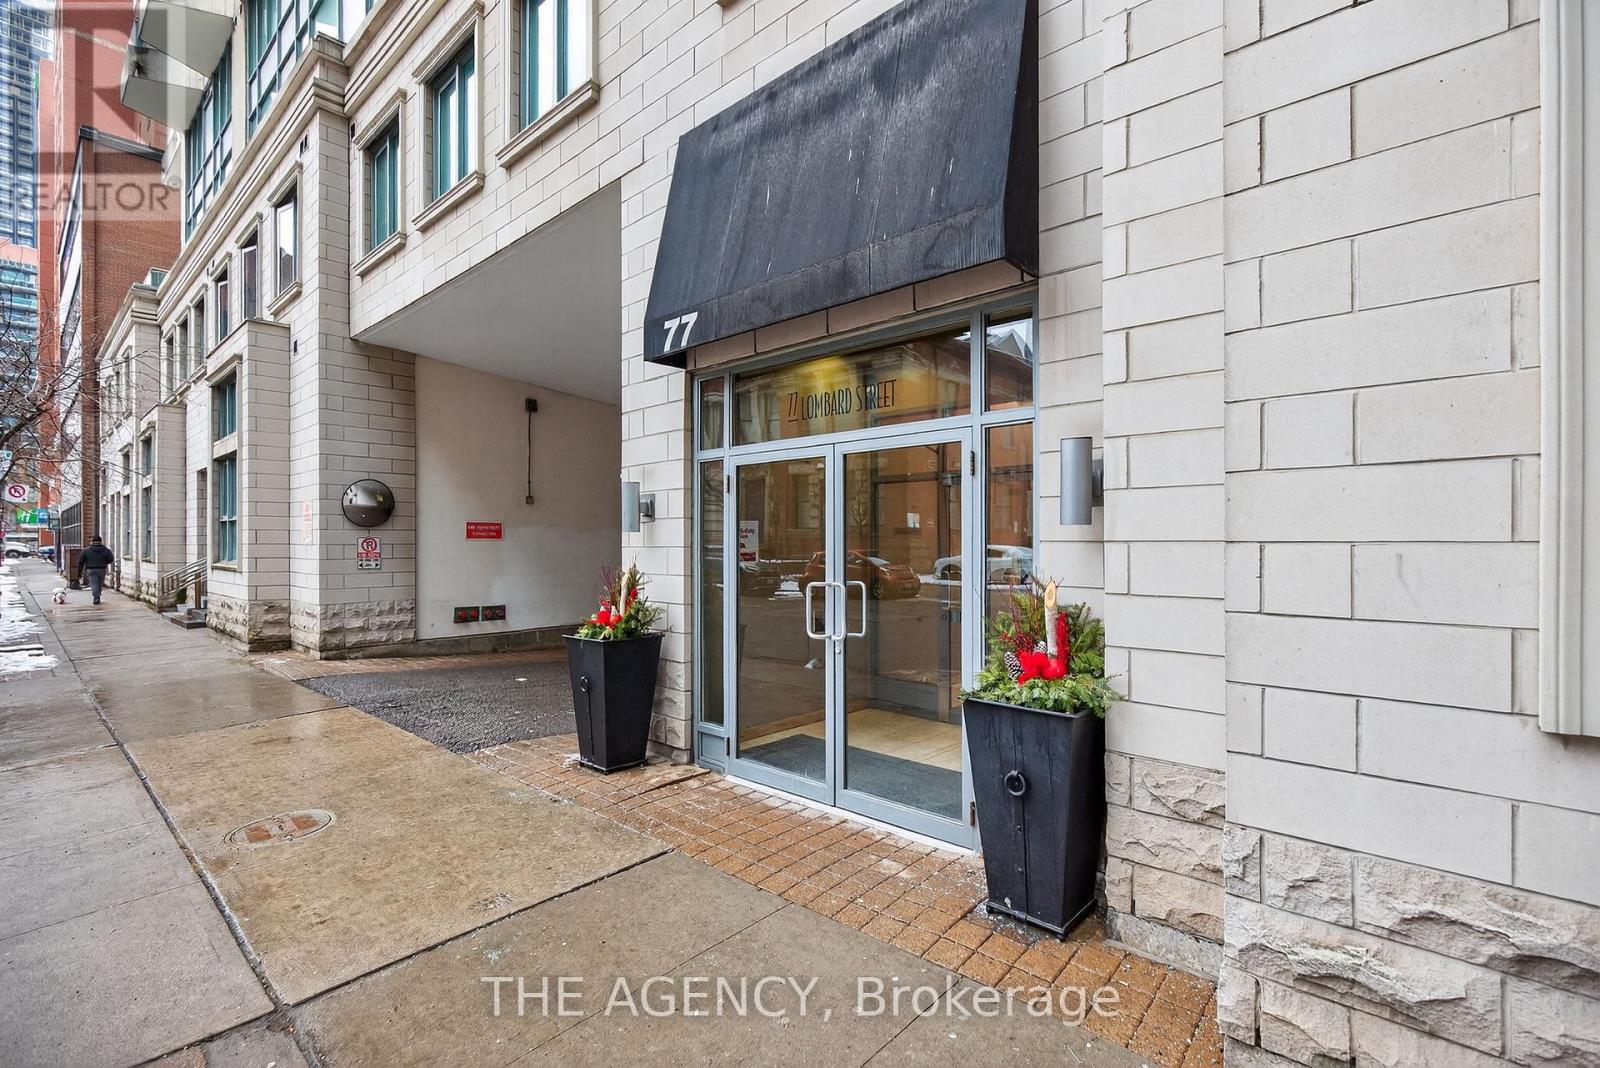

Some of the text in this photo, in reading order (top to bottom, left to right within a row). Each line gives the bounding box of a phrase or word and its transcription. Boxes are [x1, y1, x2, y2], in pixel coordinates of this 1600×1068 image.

[663, 311, 699, 352] 77
[788, 379, 897, 421] 77 LOMBARD STREET
